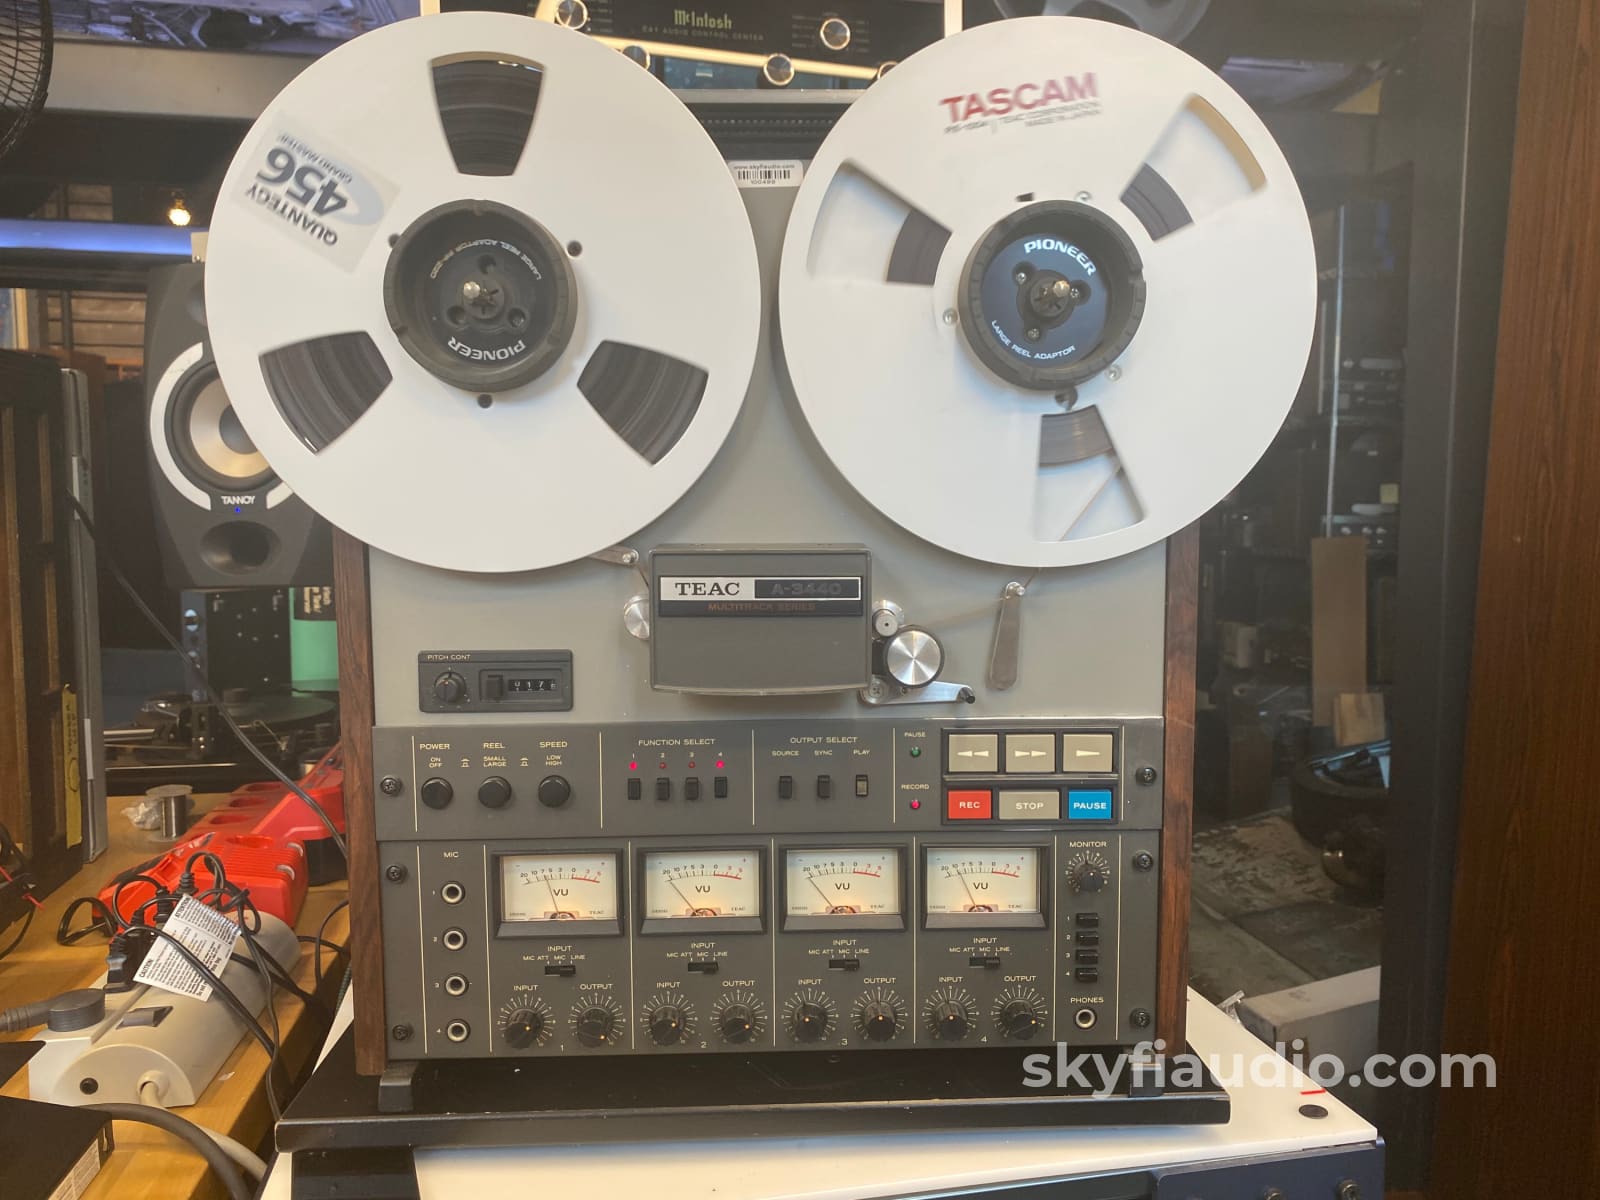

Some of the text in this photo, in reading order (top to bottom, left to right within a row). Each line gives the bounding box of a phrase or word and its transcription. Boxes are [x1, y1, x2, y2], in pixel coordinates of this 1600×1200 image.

[674, 9, 733, 29] McIntosh
[940, 71, 1097, 123] TASCAM
[256, 147, 349, 217] 456
[246, 184, 338, 246] QUANTEGY
[1024, 238, 1096, 276] PIONEER
[448, 336, 526, 360] PIONEER
[991, 320, 1076, 360] LARGE REEL ADAPTOR
[220, 495, 256, 504] TANNOY
[675, 582, 740, 596] TEAC
[958, 801, 1108, 810] REC STOP PAUSE
